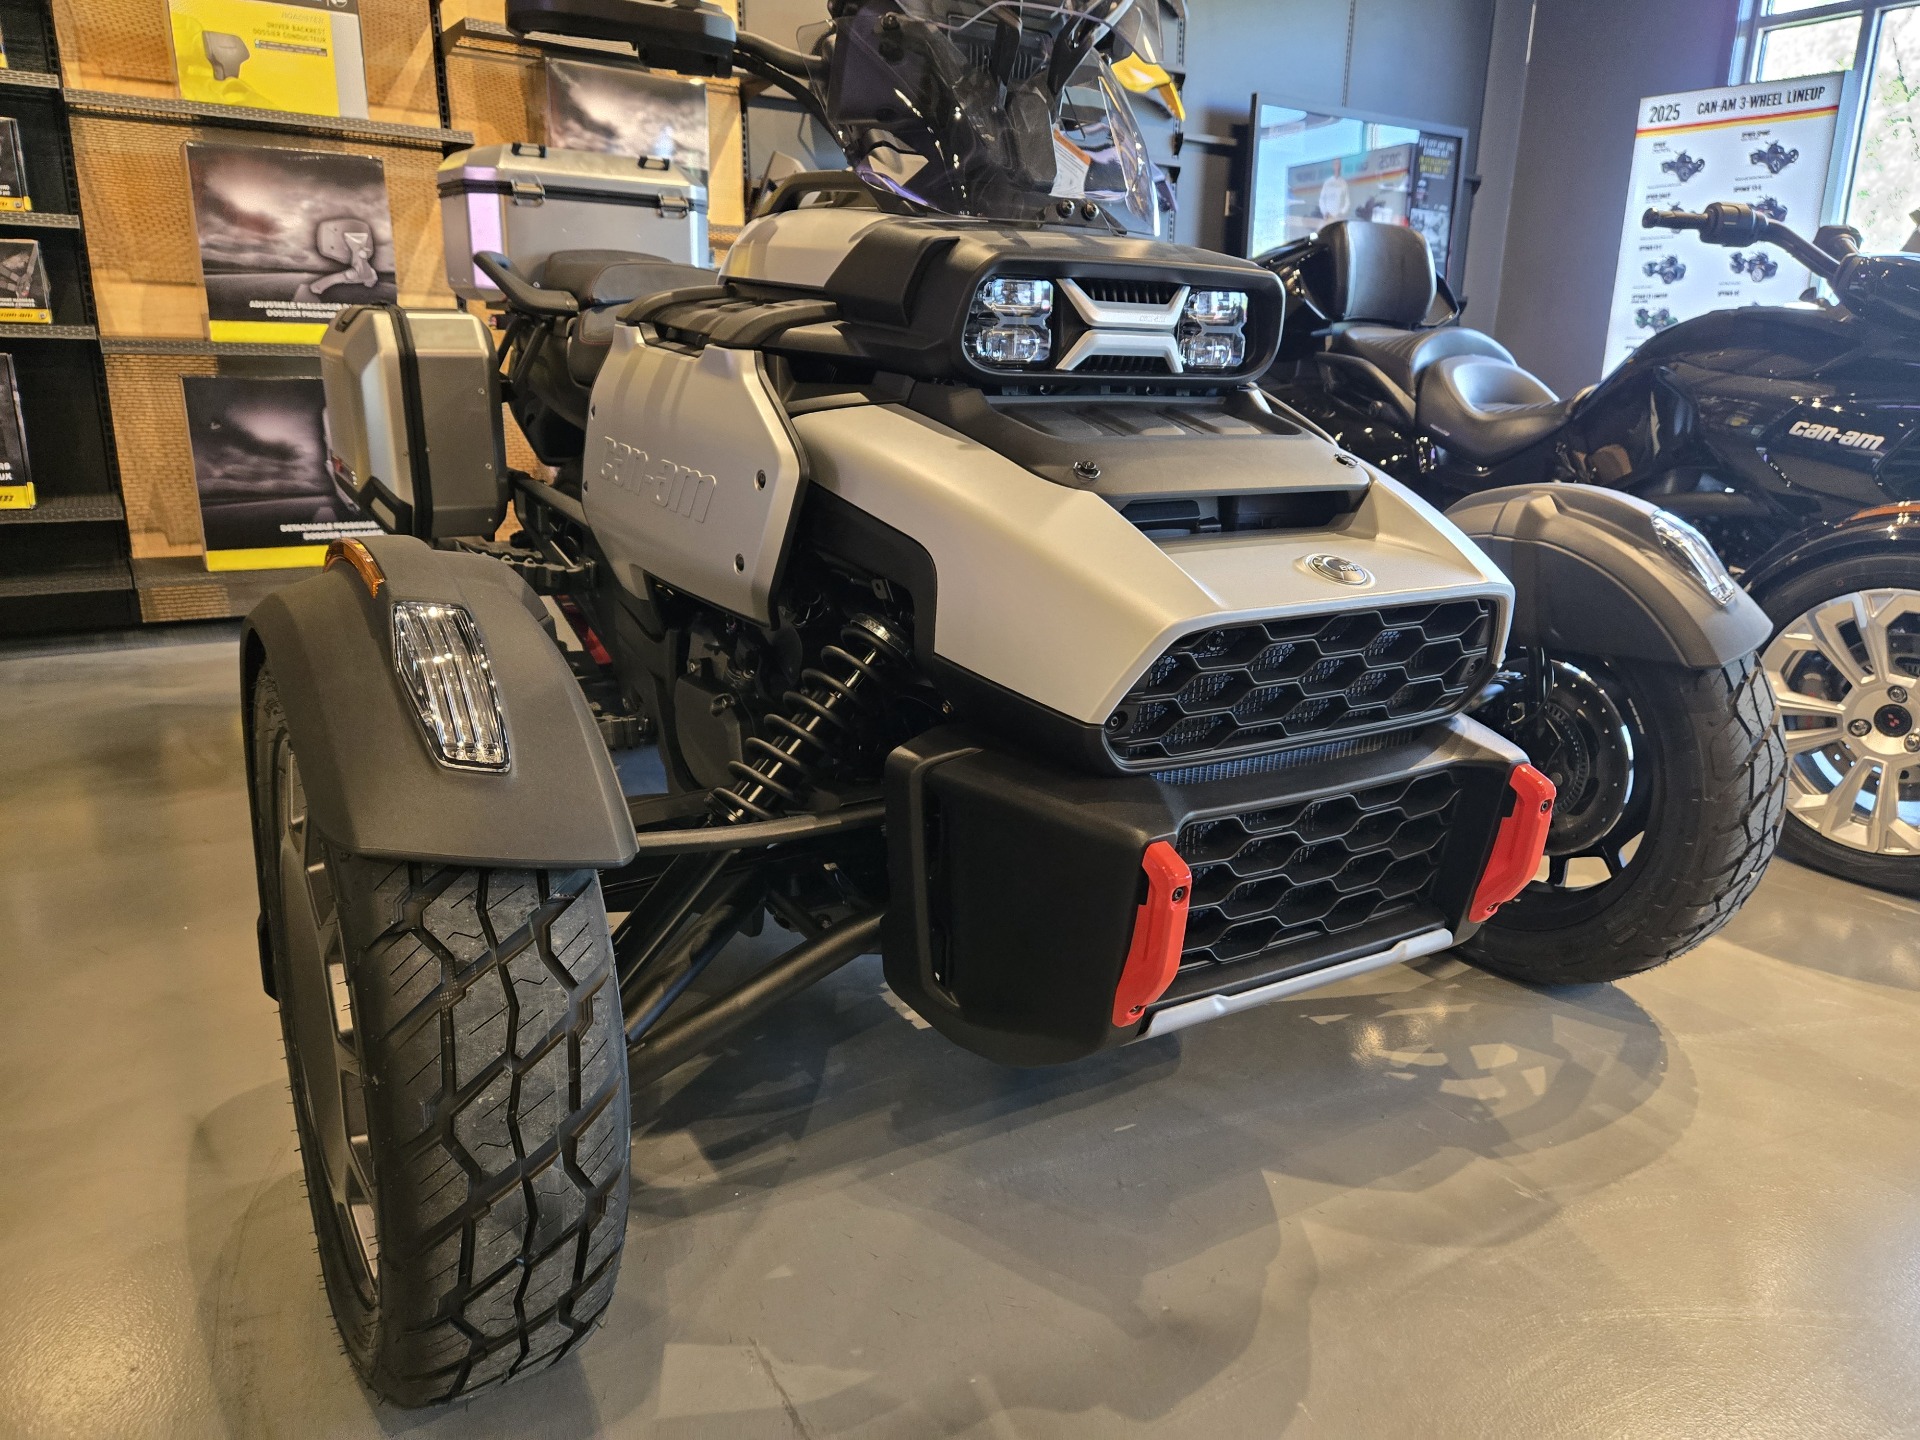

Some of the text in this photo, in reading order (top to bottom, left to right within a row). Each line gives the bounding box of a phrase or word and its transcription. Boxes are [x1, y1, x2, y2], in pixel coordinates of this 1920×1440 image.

[266, 22, 326, 36] DRIVER BACKREST
[1648, 104, 1681, 123] 2025
[1787, 86, 1826, 104] LINEUP
[1788, 421, 1885, 451] can-am
[600, 436, 717, 524] can-am
